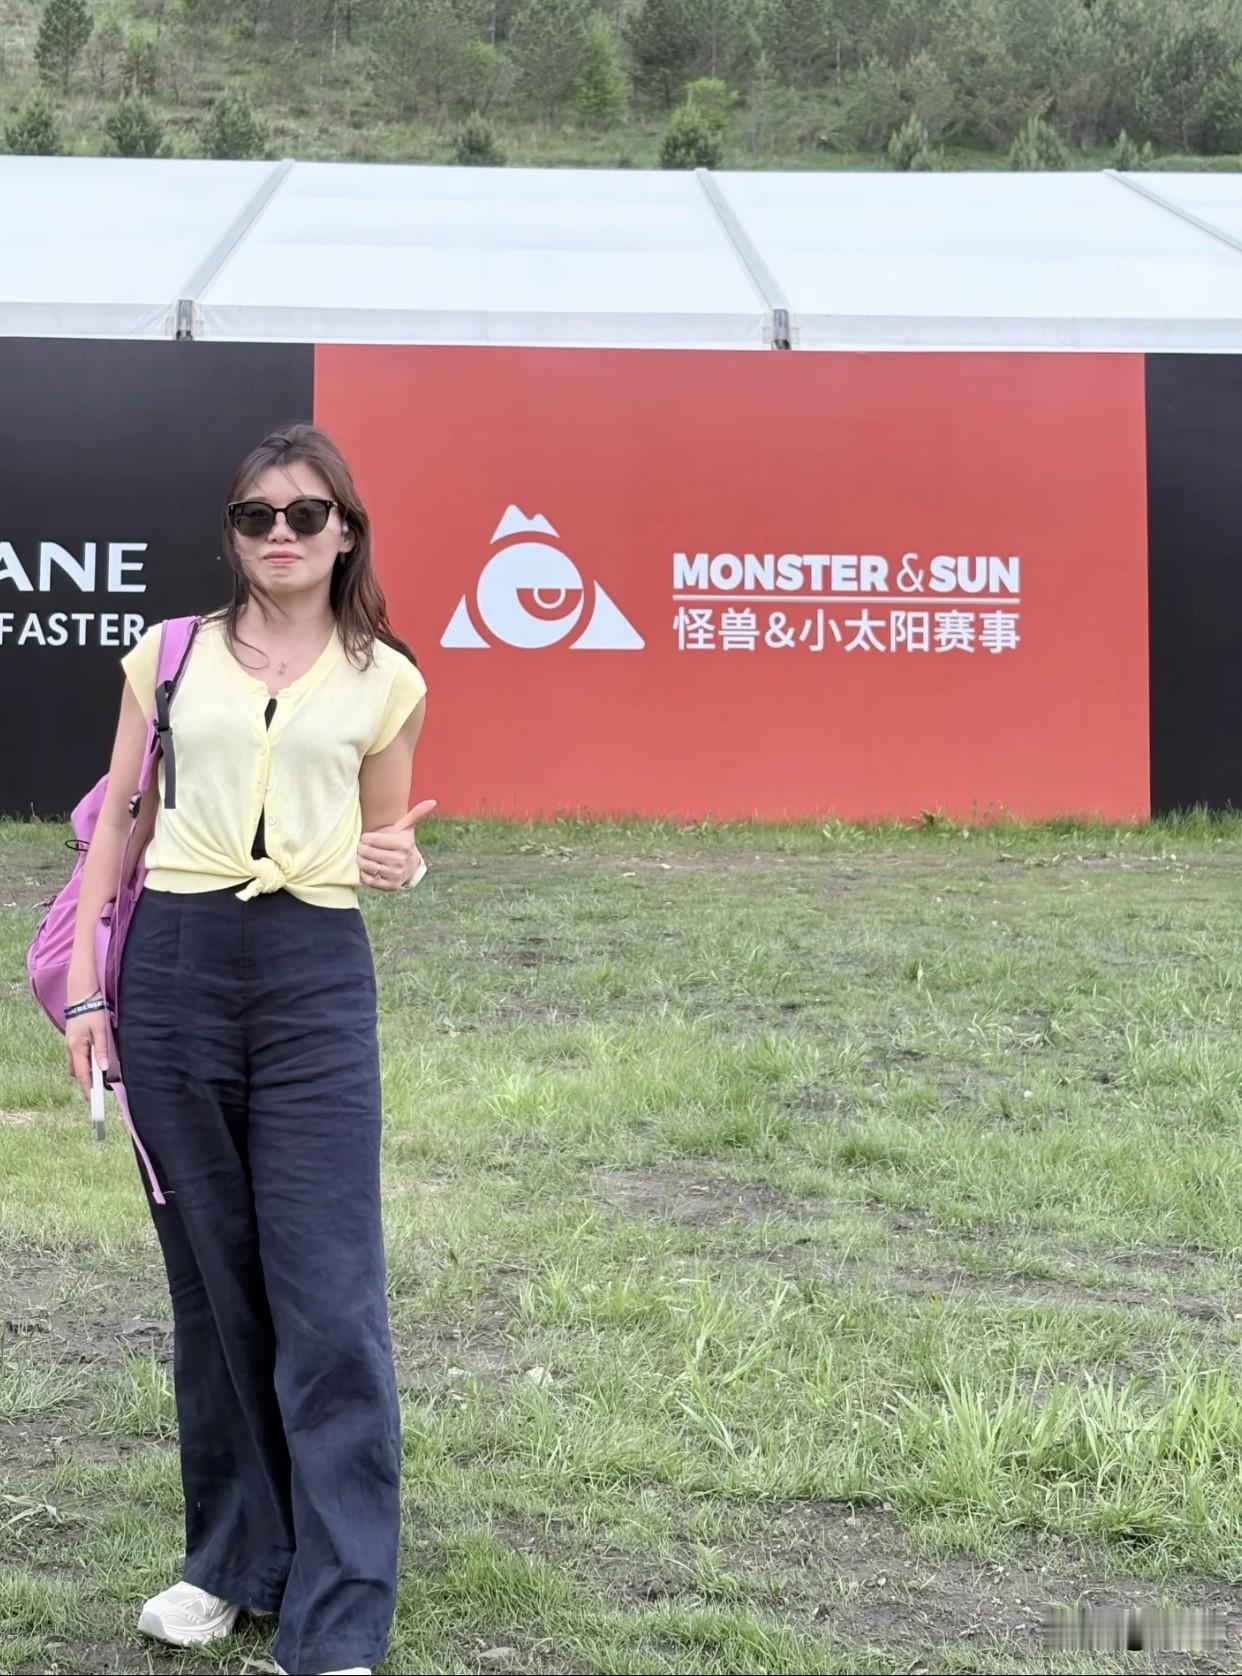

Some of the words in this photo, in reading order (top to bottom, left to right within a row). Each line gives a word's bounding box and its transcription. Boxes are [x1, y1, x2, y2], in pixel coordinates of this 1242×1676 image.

[0, 612, 145, 646] FASTER
[672, 606, 1021, 653] 怪兽&小太阳赛事
